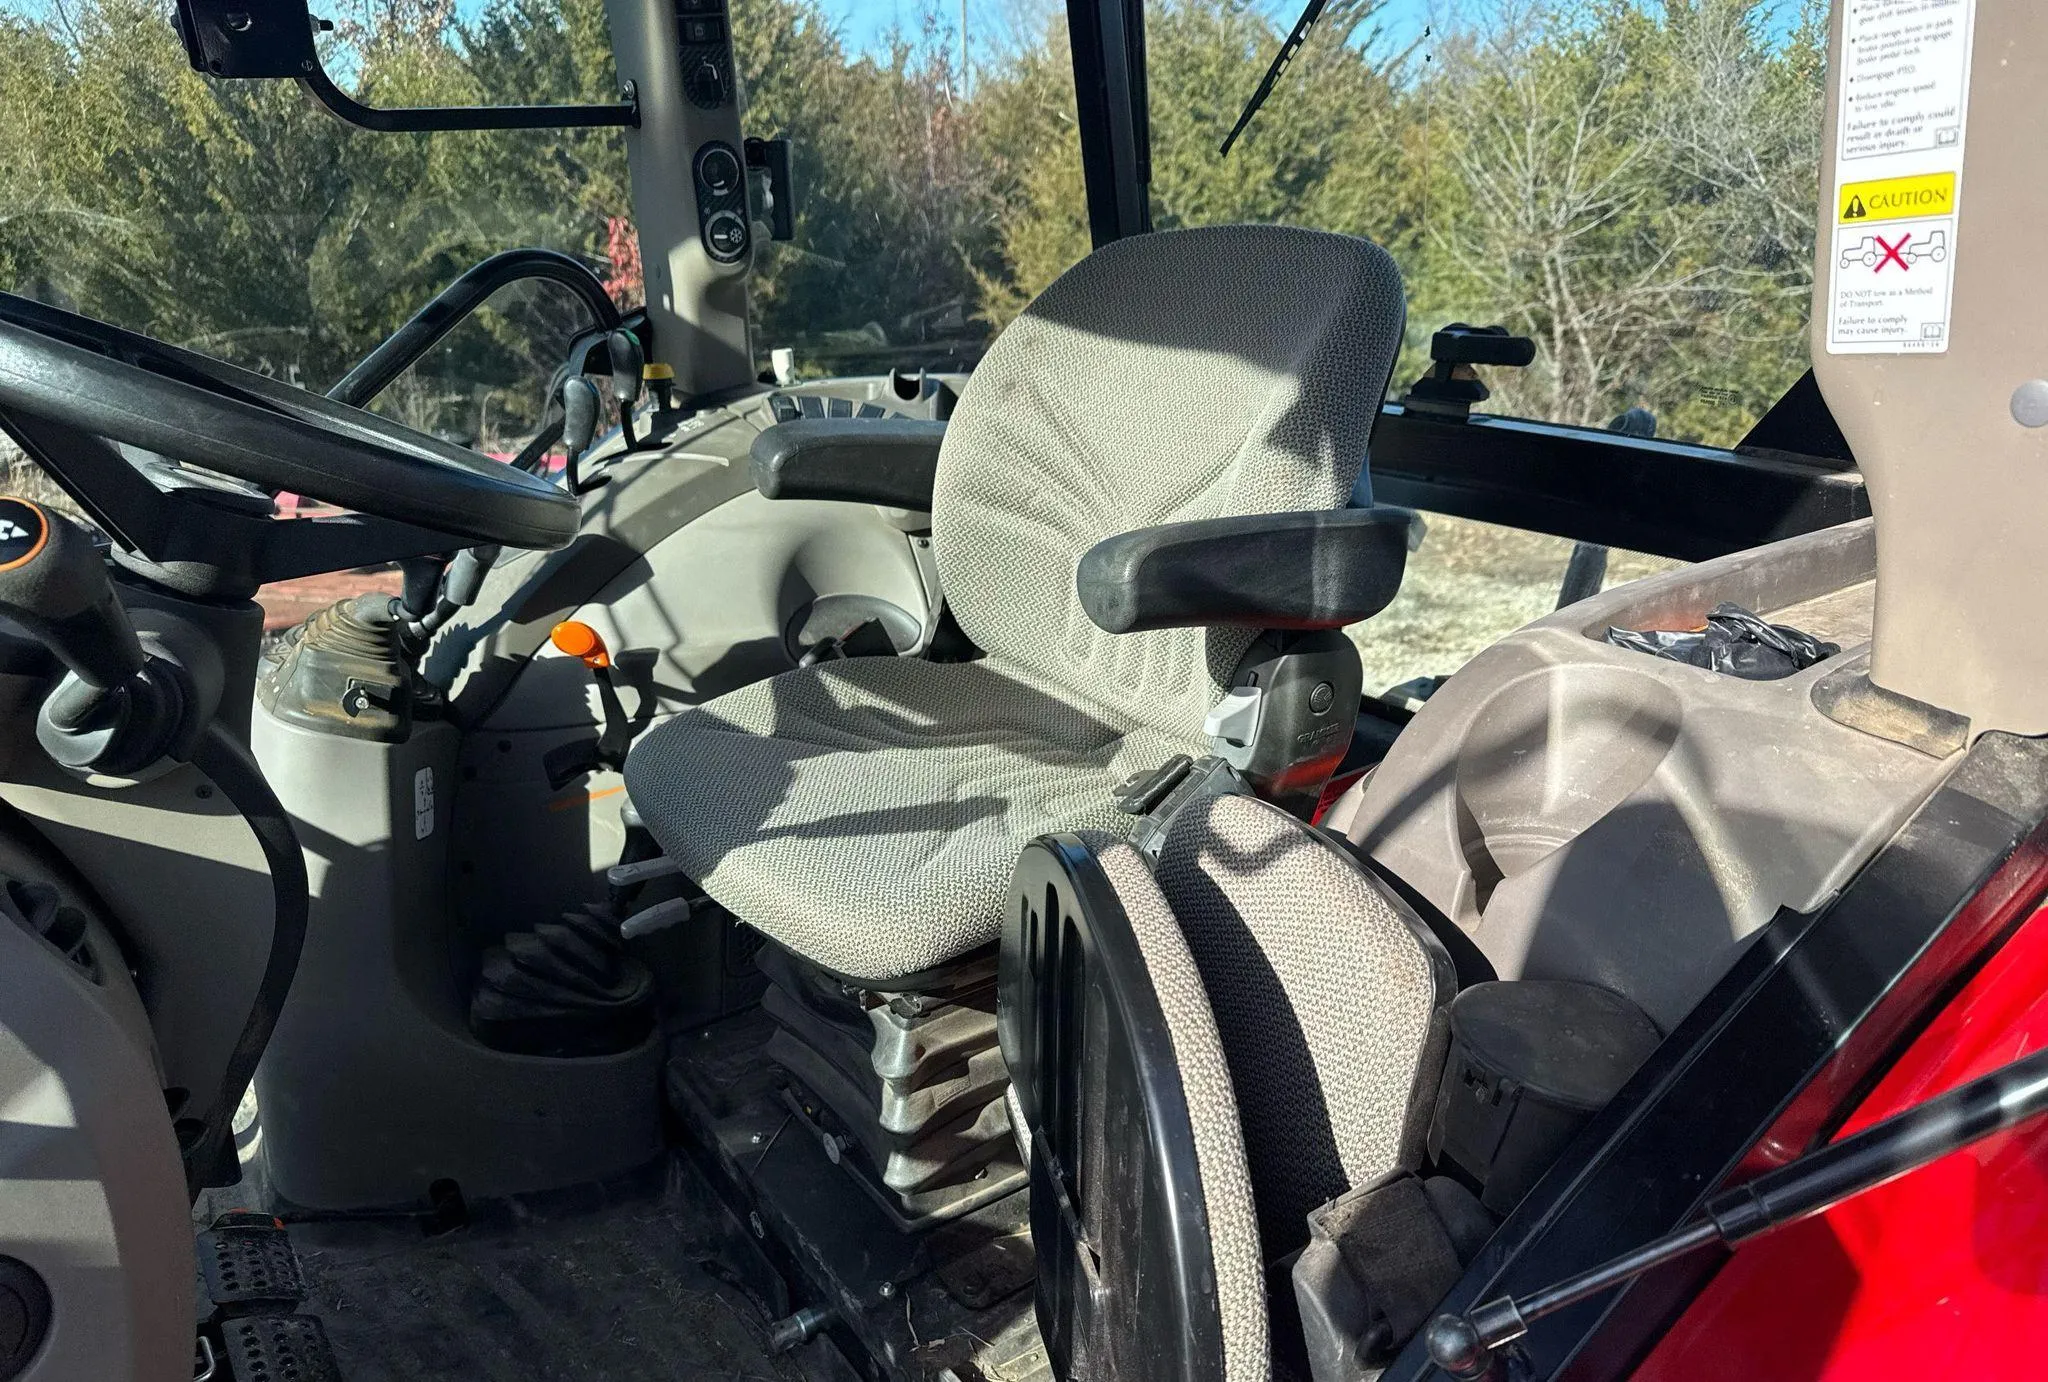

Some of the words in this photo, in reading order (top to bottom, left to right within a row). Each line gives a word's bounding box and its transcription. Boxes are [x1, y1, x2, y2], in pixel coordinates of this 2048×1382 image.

[1847, 121, 1877, 131] Failure
[1879, 117, 1889, 126] to
[1891, 112, 1925, 125] comply
[1927, 105, 1956, 120] could
[1846, 143, 1876, 154] serious
[1869, 188, 1948, 210] CAUTION
[1840, 290, 1853, 299] DO
[1854, 289, 1873, 298] NOT
[1904, 286, 1933, 296] Method
[1838, 316, 1865, 325] Failure
[1867, 315, 1876, 324] to
[1878, 314, 1908, 326] comply
[1838, 327, 1854, 336] may
[1856, 326, 1879, 335] cause
